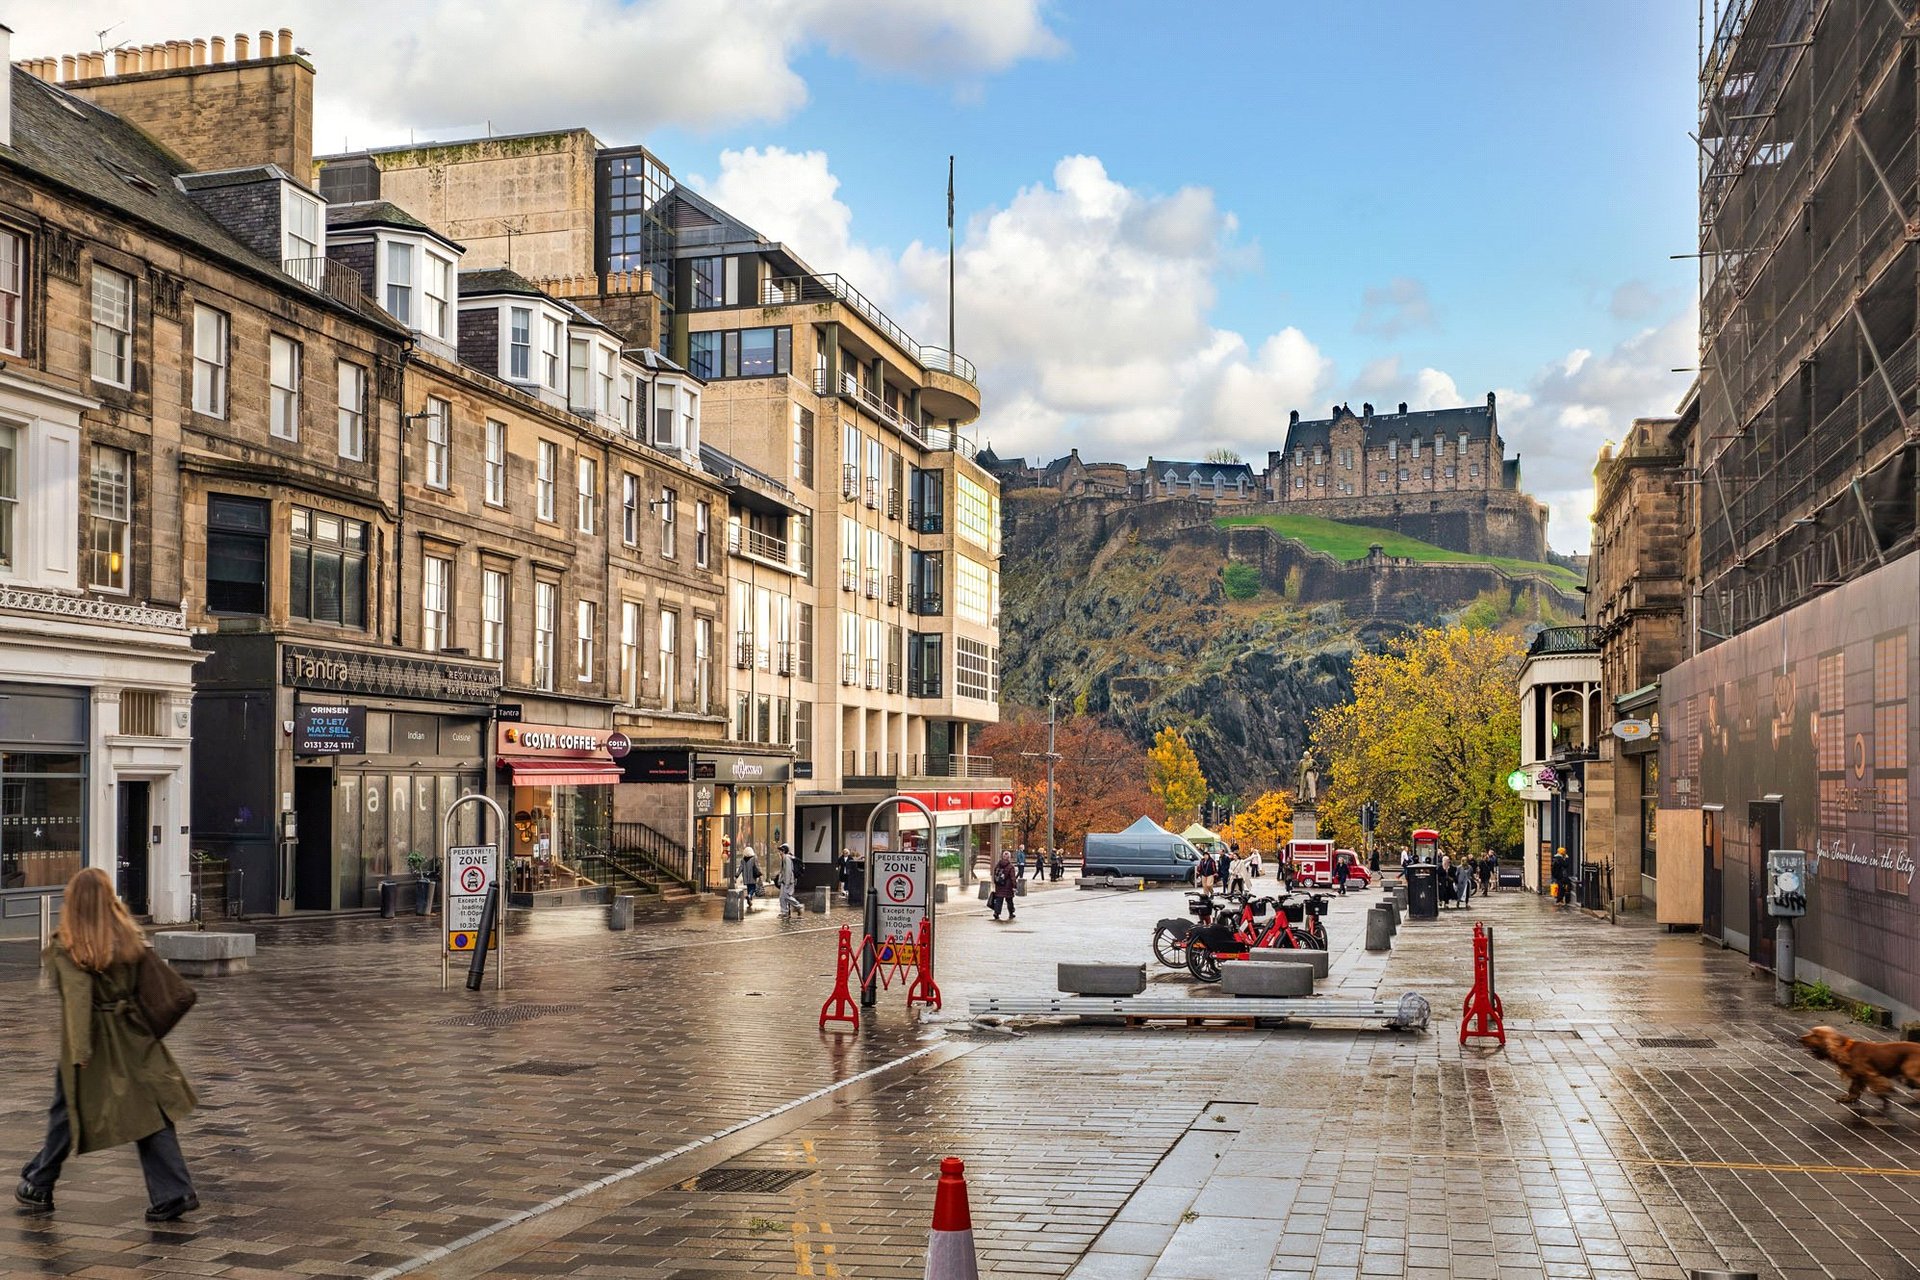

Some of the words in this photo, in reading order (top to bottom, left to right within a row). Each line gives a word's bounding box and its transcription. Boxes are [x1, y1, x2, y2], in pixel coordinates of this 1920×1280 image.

[295, 654, 347, 681] Tantra
[311, 706, 349, 714] ORINSEN
[499, 709, 520, 717] Tantra
[329, 726, 351, 734] SELL
[407, 731, 425, 740] Indian
[452, 732, 471, 741] Cuisine
[304, 741, 322, 749] 0131
[324, 741, 338, 749] 374
[525, 732, 557, 749] COSTA
[560, 734, 597, 751] COFFEE
[459, 856, 488, 865] ZONE
[877, 854, 923, 862] PEDESTRIAN
[884, 862, 916, 873] ZONE
[1869, 849, 1878, 866] in
[1880, 848, 1894, 869] the
[1896, 850, 1916, 884] City
[457, 897, 478, 905] Except
[882, 907, 905, 915] Except
